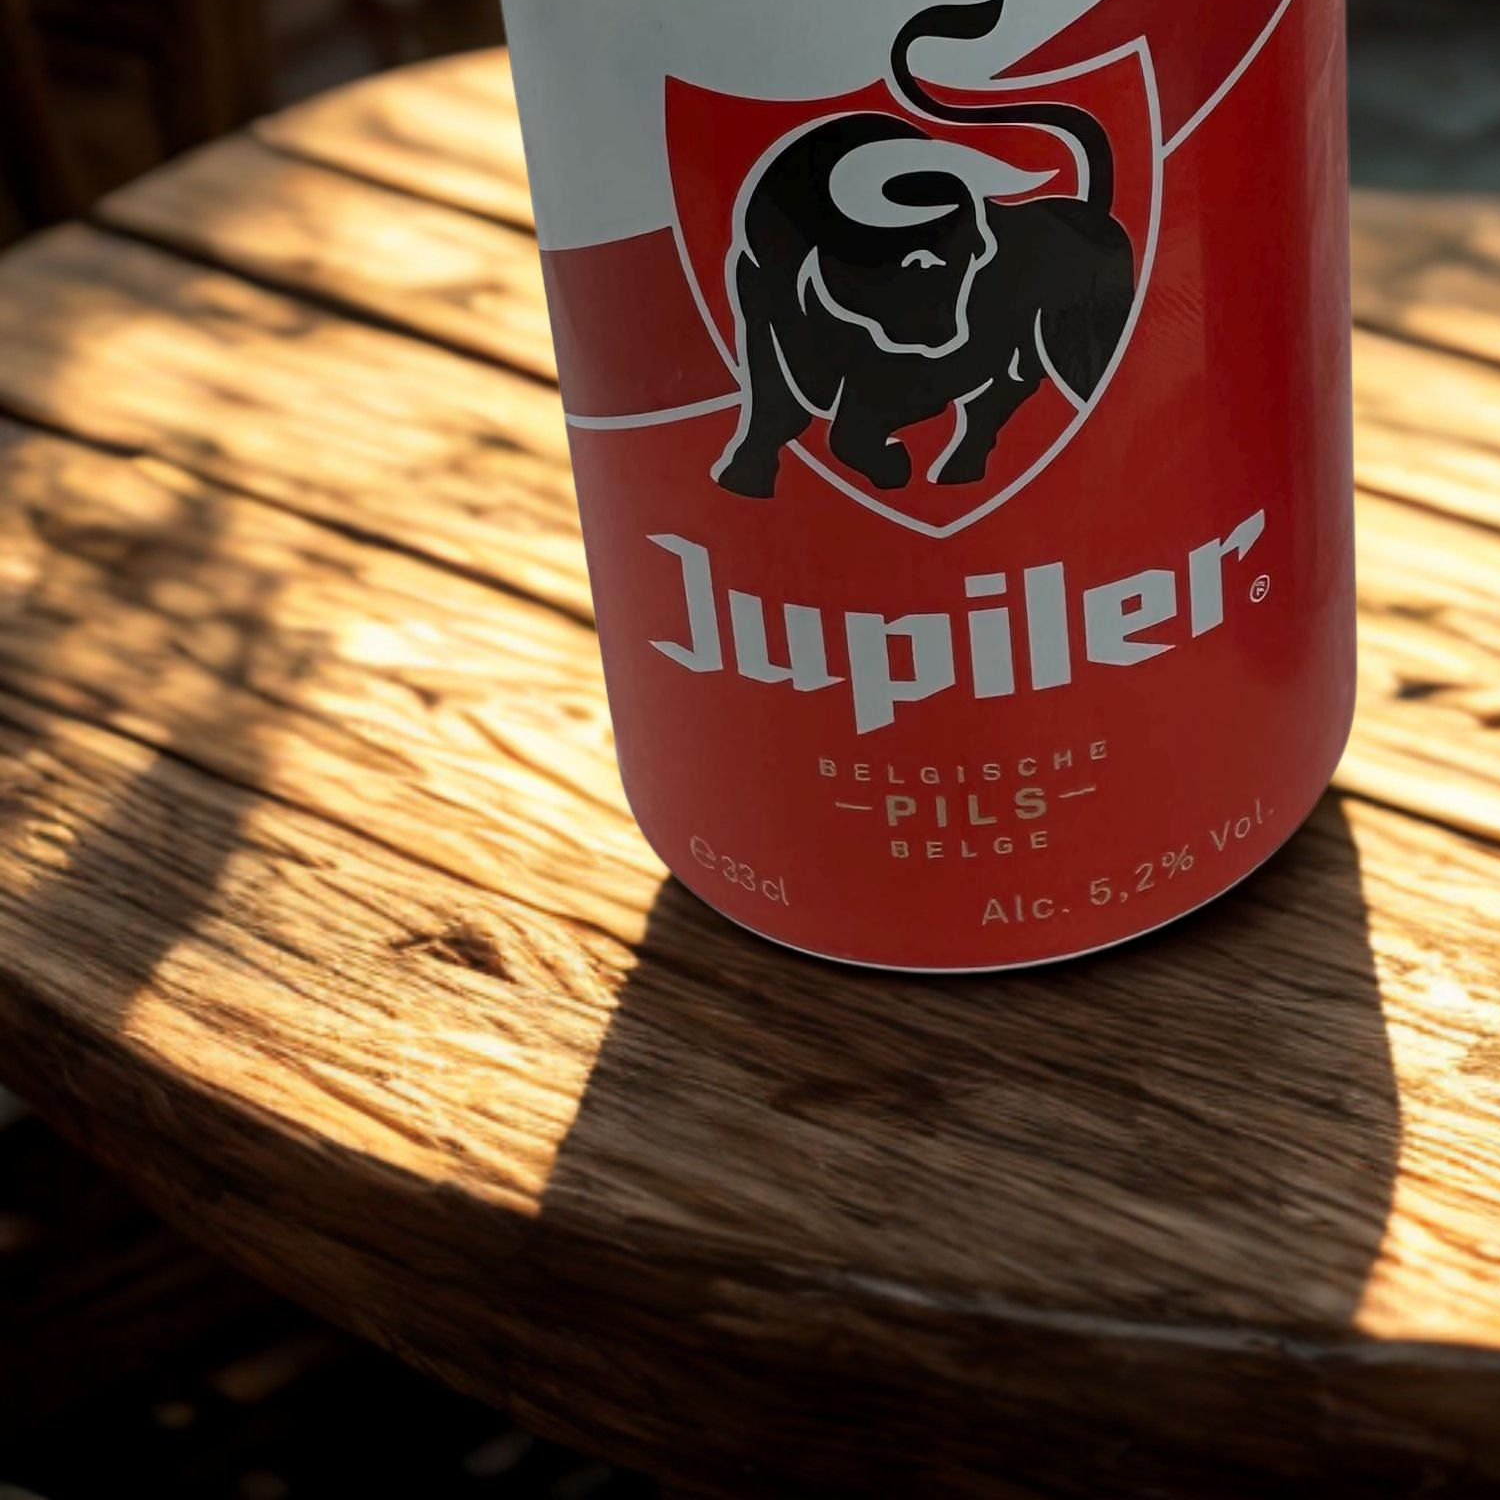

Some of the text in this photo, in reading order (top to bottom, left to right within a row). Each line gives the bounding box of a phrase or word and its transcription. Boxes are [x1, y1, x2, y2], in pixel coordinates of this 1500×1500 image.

[645, 508, 1265, 735] Jupiler
[818, 739, 1108, 784] BELGISCHE
[886, 786, 1048, 827] PILS
[891, 830, 1049, 858] BELGE
[981, 798, 1275, 926] Alc. 5,2% Vol.
